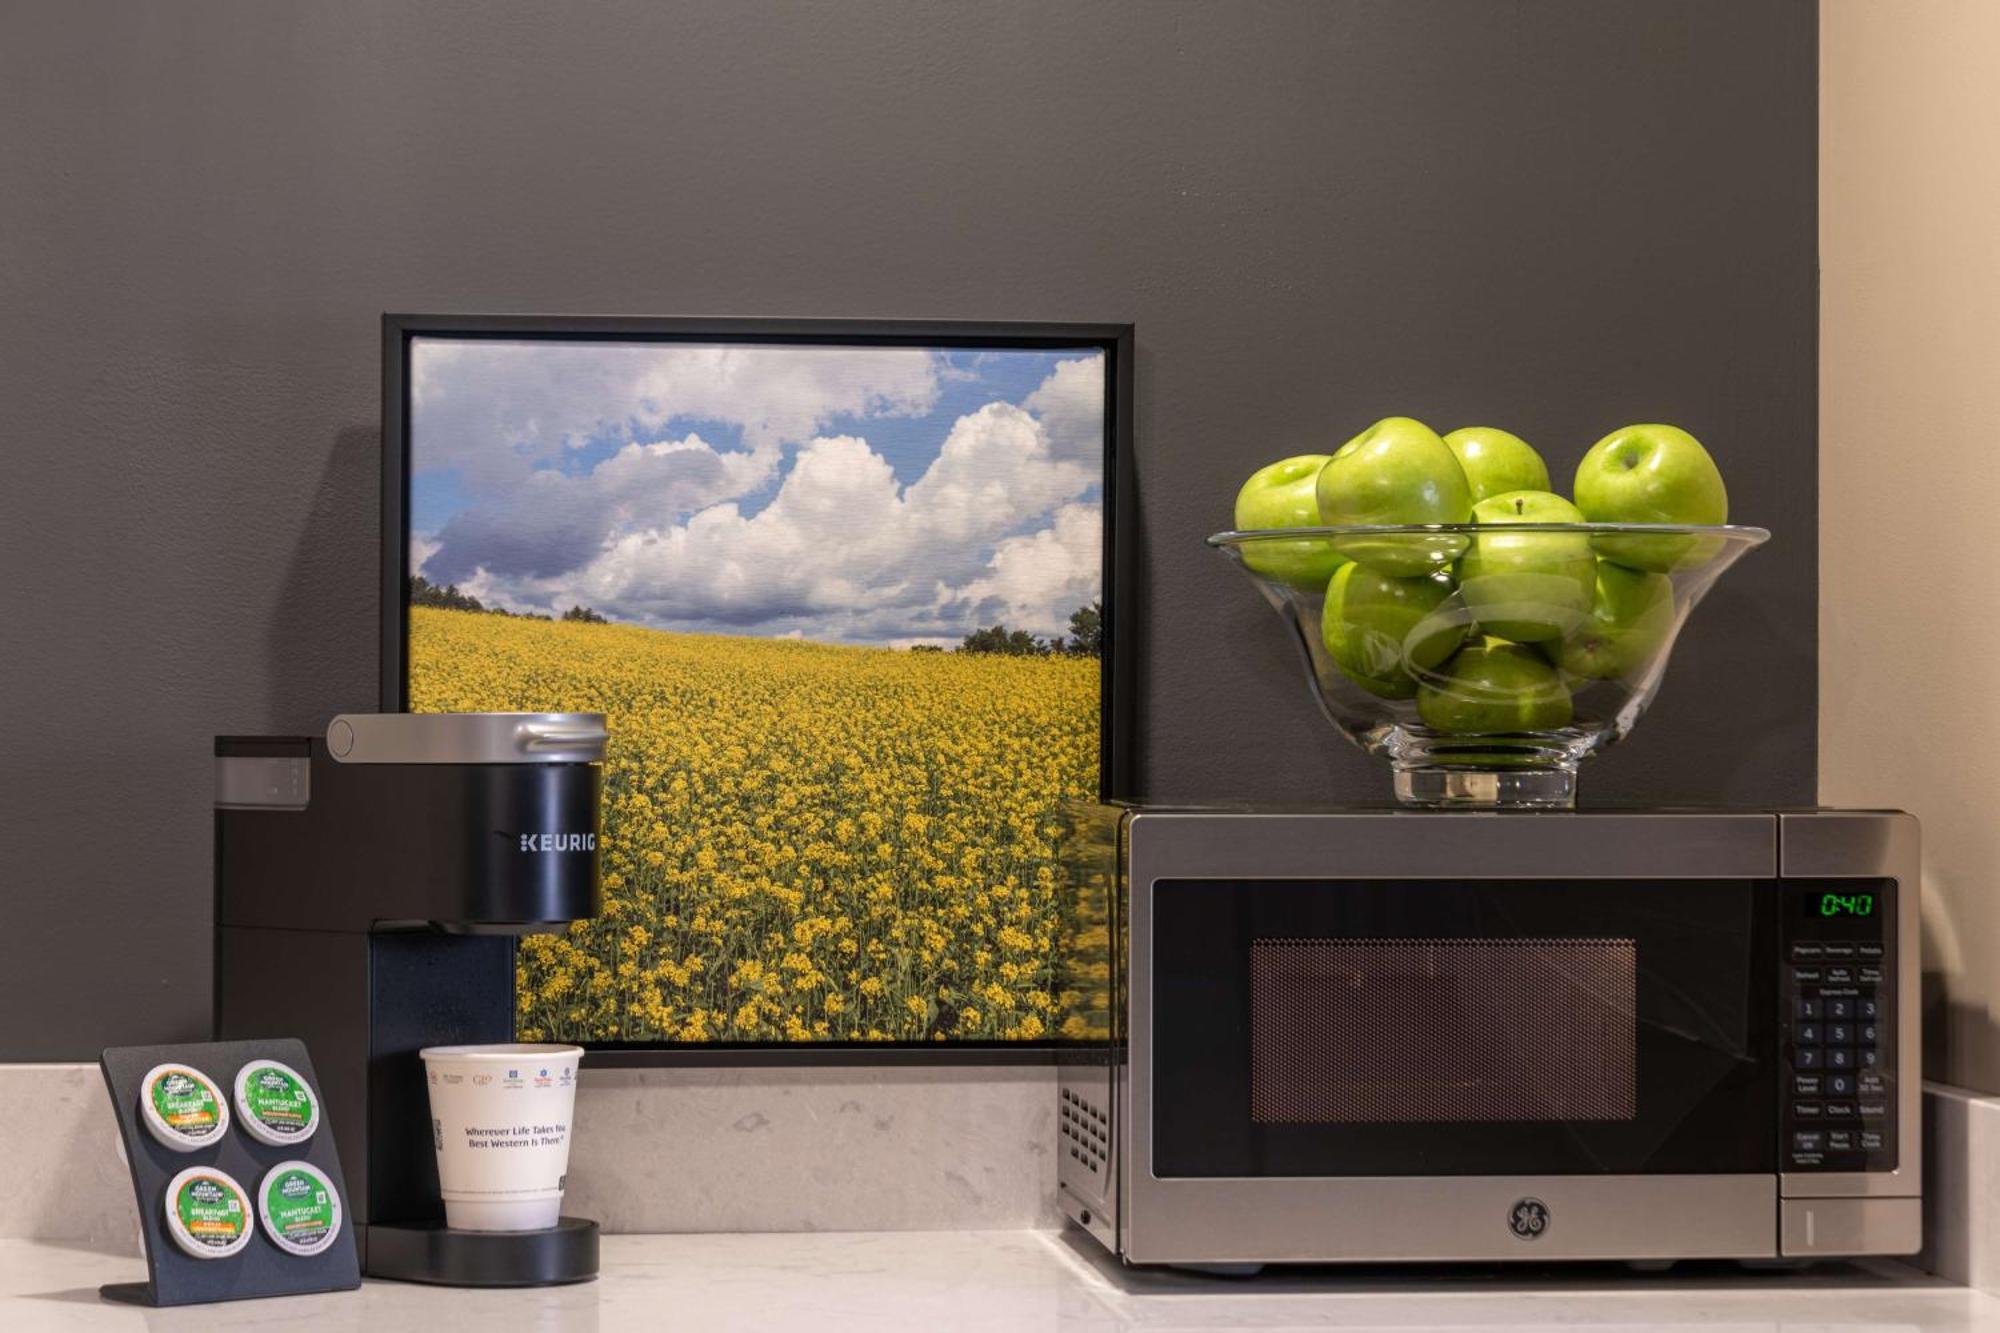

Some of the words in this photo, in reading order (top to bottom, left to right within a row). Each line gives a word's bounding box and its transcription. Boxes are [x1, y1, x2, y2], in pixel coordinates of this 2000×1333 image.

[520, 833, 596, 852] KEURIG
[1821, 894, 1872, 915] 0:40
[1806, 1003, 1813, 1015] 1
[1835, 1003, 1844, 1015] 2
[1866, 1003, 1875, 1015] 3
[1803, 1028, 1814, 1039] 4
[1835, 1027, 1844, 1039] 5
[1865, 1027, 1875, 1039] 6
[1804, 1053, 1813, 1065] 7
[1834, 1052, 1845, 1065] 8
[1866, 1052, 1875, 1065] 9
[1834, 1078, 1845, 1091] 0
[465, 1127, 509, 1137] Wherever
[512, 1126, 530, 1135] Life
[533, 1125, 554, 1134] Takes
[469, 1139, 488, 1148] Best
[490, 1139, 529, 1148] Western
[531, 1138, 538, 1147] Is
